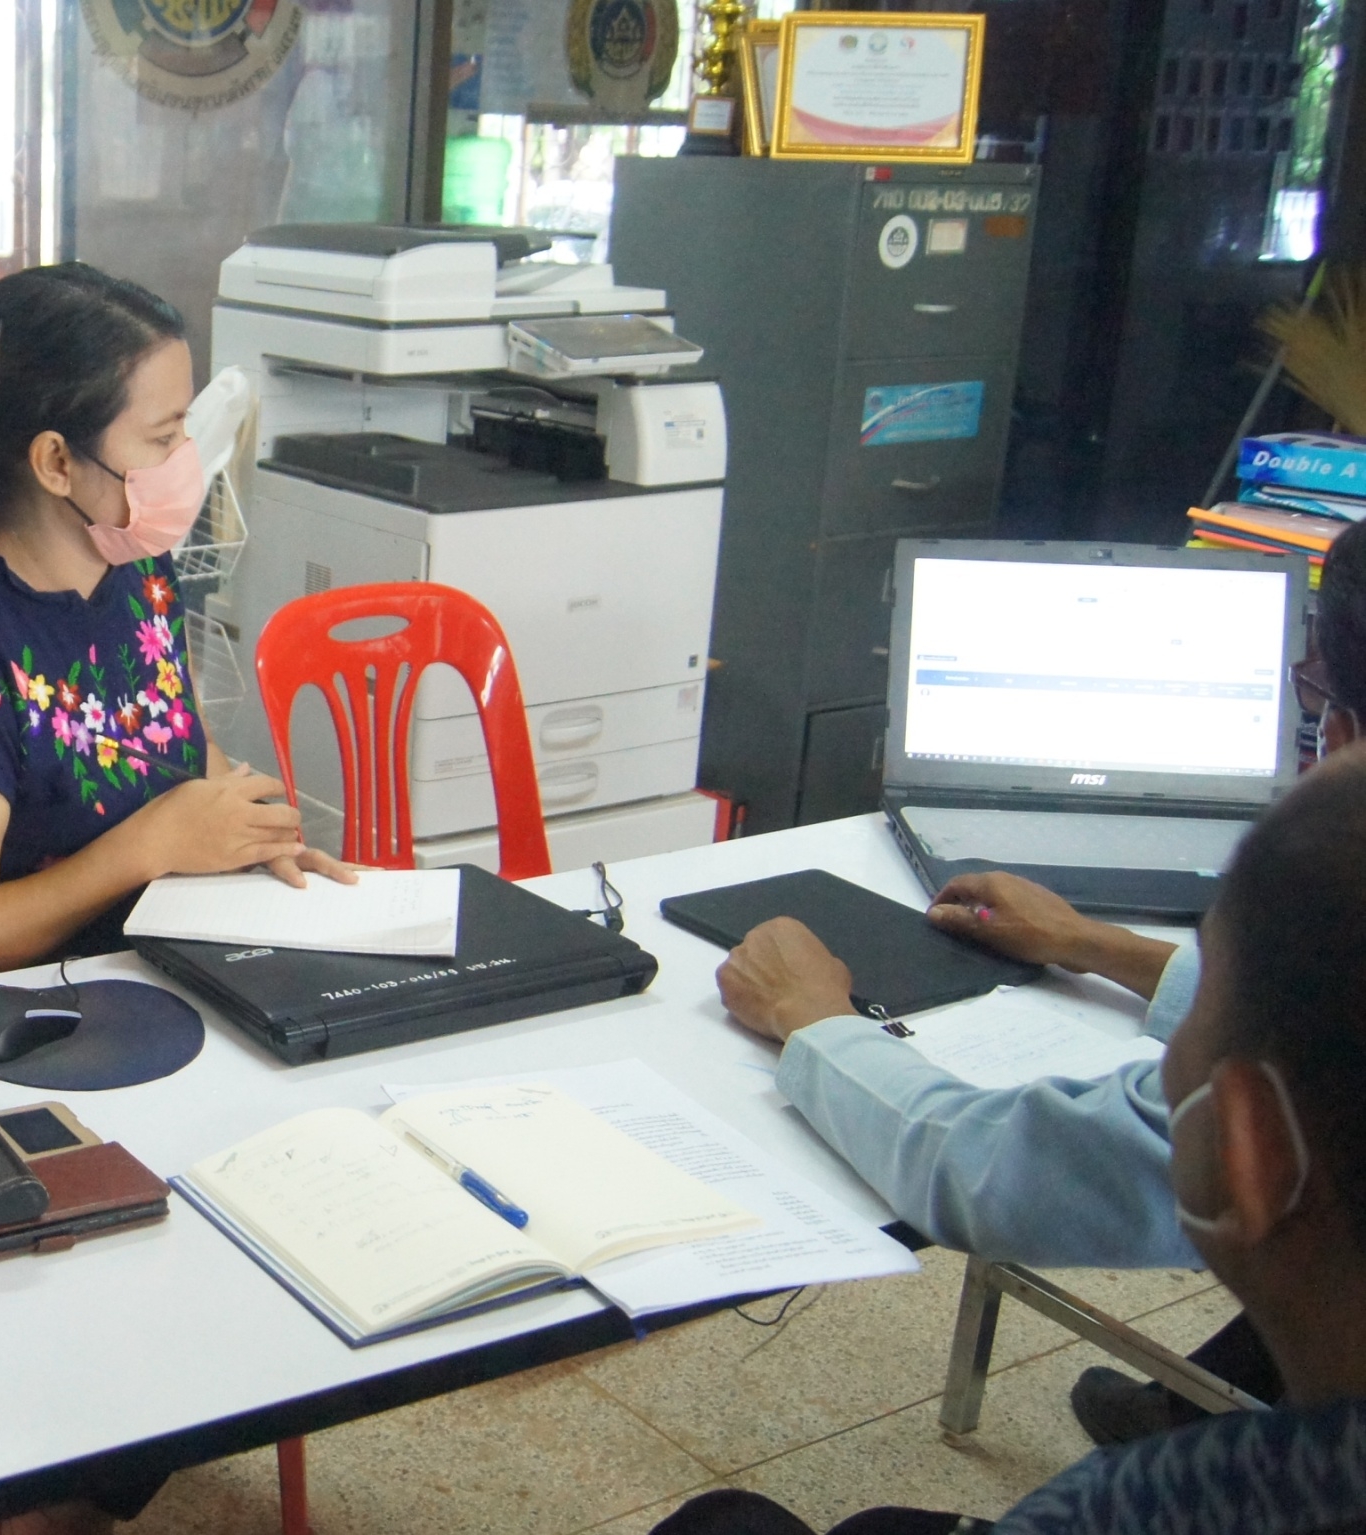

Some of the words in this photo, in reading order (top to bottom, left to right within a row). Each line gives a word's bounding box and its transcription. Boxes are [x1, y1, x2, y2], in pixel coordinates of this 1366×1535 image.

[1252, 451, 1333, 475] Double
[1340, 462, 1357, 478] A
[1070, 773, 1107, 786] msi
[225, 948, 274, 962] acer
